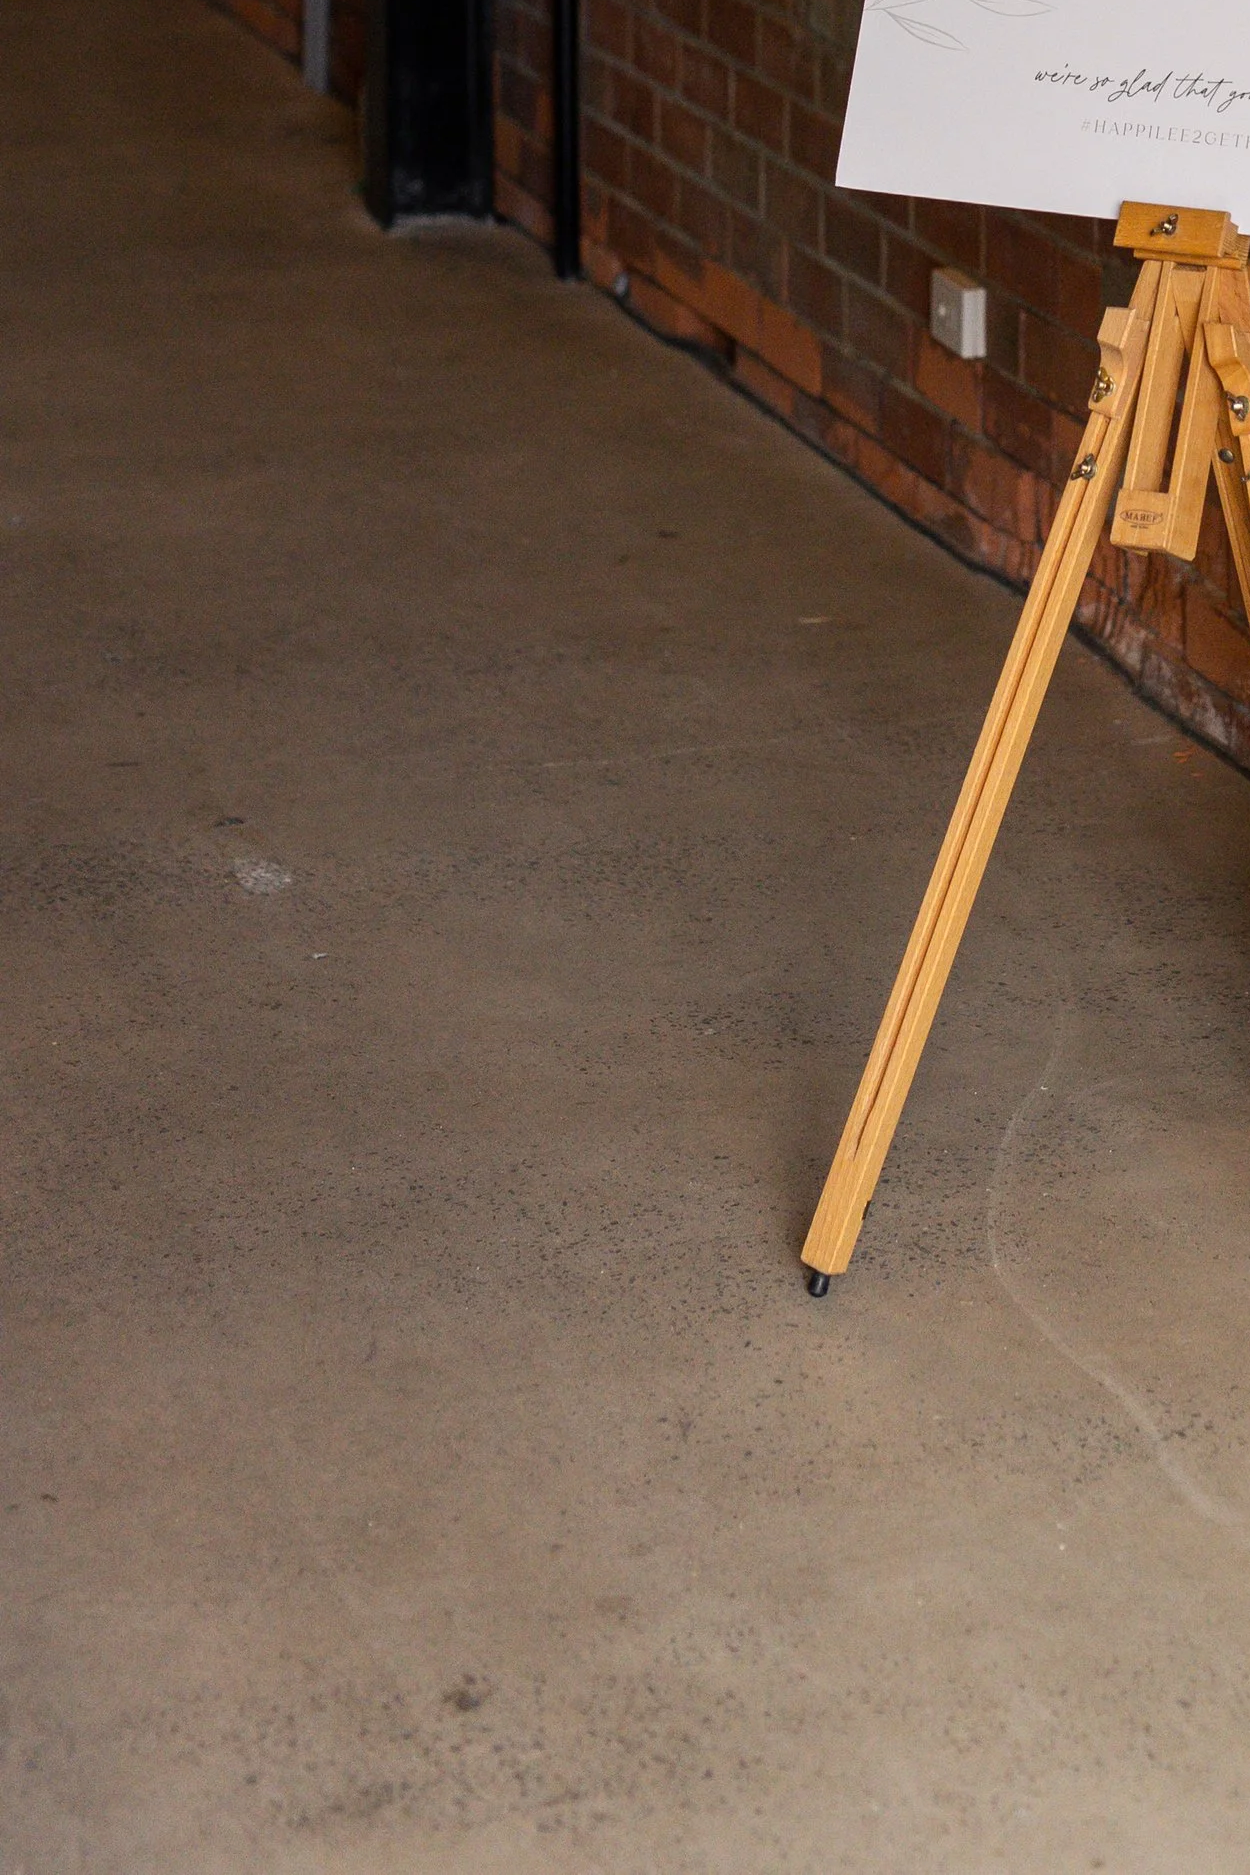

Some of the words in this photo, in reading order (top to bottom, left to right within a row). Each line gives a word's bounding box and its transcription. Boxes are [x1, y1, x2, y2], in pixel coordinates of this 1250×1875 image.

[1034, 63, 1088, 85] we're
[1089, 75, 1115, 91] so
[1107, 68, 1174, 103] glad
[1173, 73, 1233, 107] that
